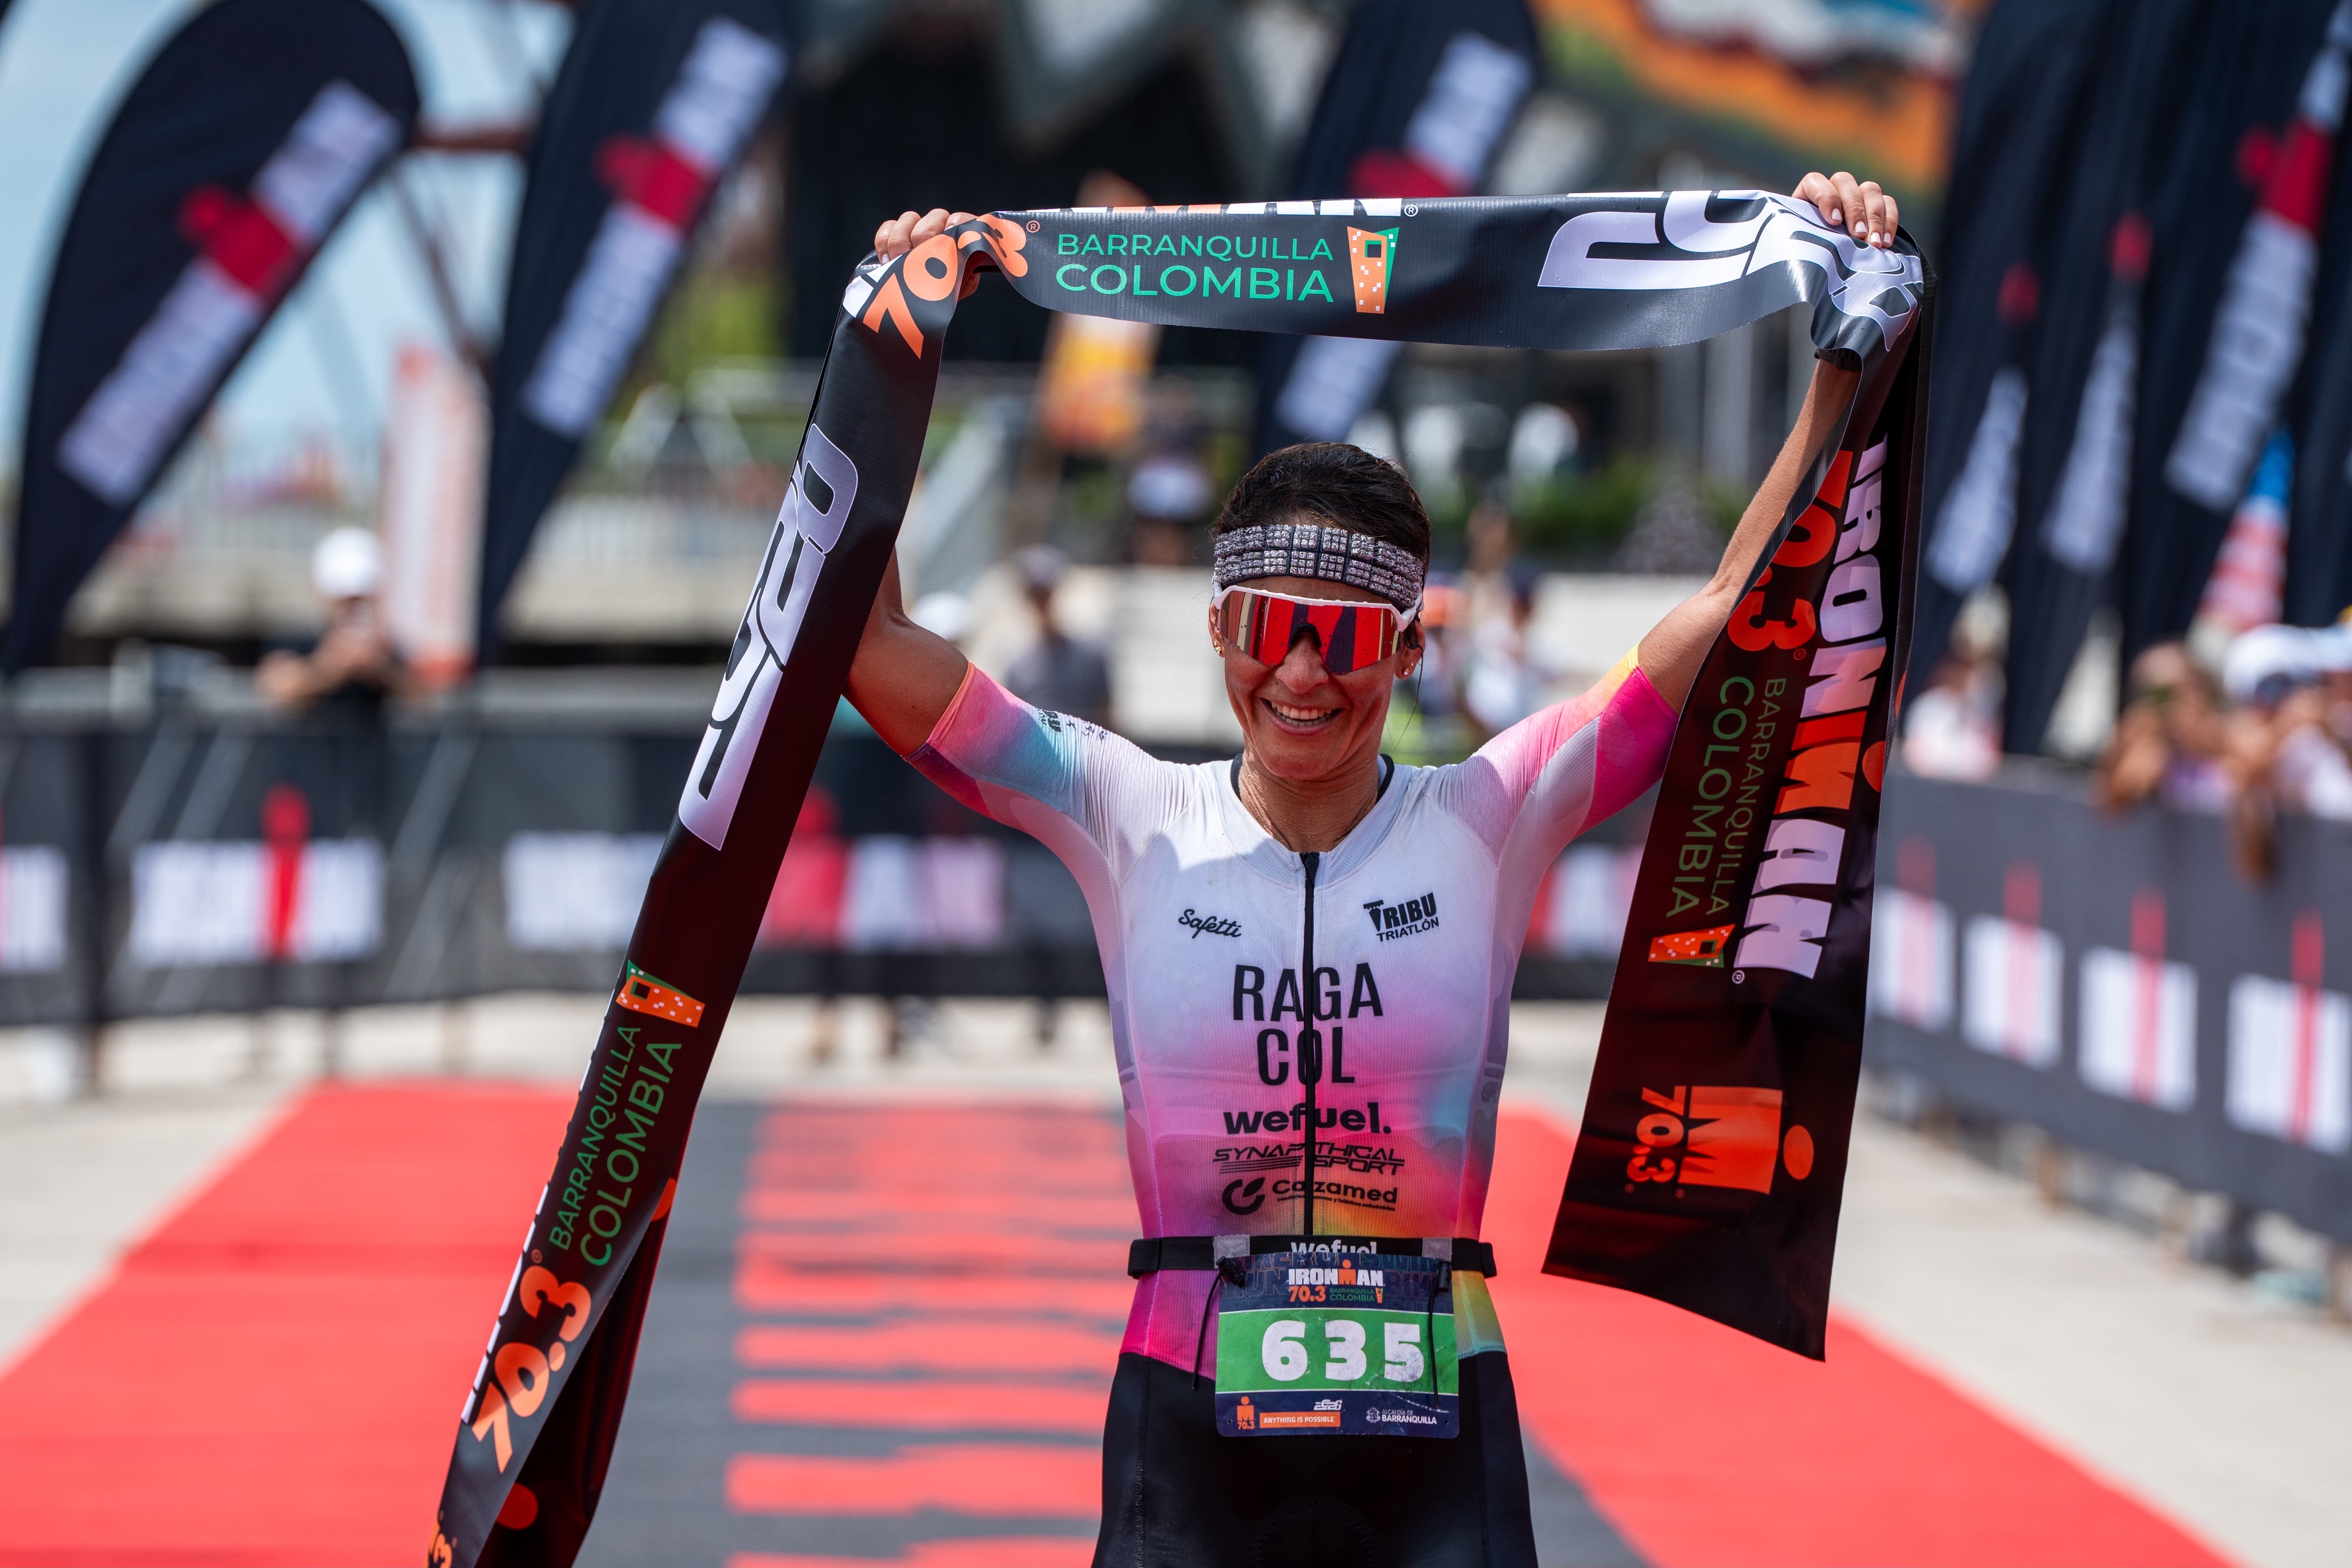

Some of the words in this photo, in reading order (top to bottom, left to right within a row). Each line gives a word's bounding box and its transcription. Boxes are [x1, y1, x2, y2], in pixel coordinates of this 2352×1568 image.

[1057, 233, 1334, 261] BARRANQUILLA
[1055, 263, 1334, 302] COLOMBIA
[1733, 432, 1888, 979] IRONMAN
[1665, 675, 1755, 919] COLOMBIA
[1705, 677, 1787, 916] BARRANQUILLA
[1178, 908, 1242, 939] Safetti
[1363, 892, 1437, 932] TRIBU
[1376, 916, 1439, 942] TRIATLÓN
[1233, 962, 1384, 1022] RAGA
[1256, 1026, 1355, 1086] COL
[548, 1025, 641, 1251] BARRANQUILLA
[580, 1042, 682, 1266] COLOMBIA
[1625, 1084, 1688, 1184] 70.3
[1313, 1154, 1405, 1176] SPORT
[1288, 1260, 1383, 1287] IRONMAN
[1289, 1285, 1326, 1302] 70.3
[471, 1265, 591, 1474] 70.3
[1261, 1319, 1425, 1383] 635
[1237, 1421, 1255, 1430] 70.3
[1381, 1414, 1437, 1425] BARRANQUILLA
